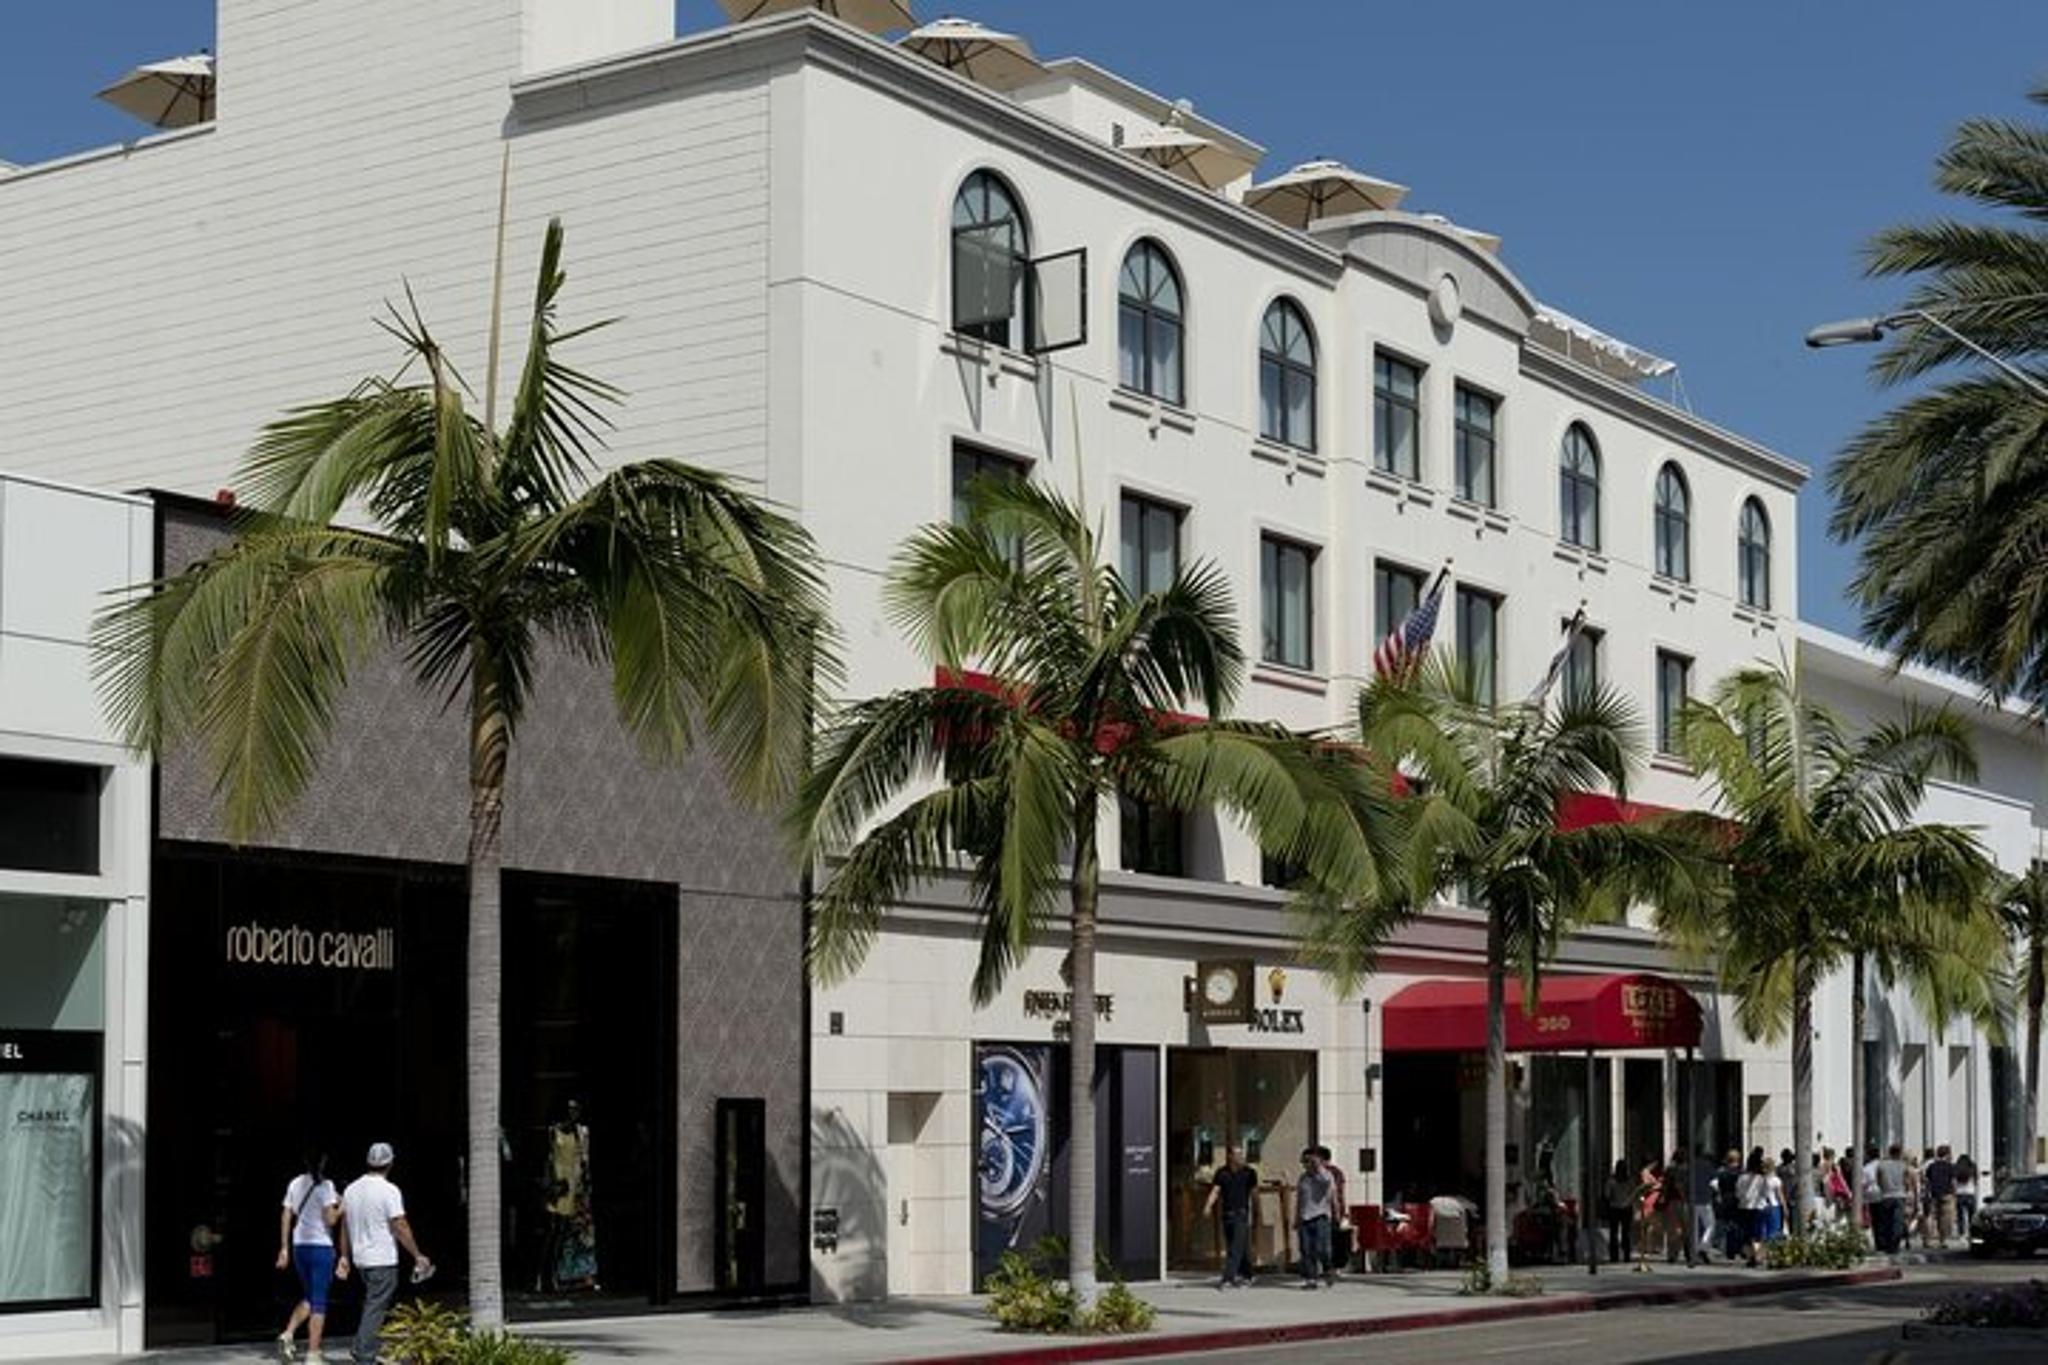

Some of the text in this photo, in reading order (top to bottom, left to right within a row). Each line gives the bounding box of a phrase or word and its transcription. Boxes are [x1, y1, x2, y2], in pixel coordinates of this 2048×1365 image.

[227, 920, 394, 970] roberto cavalli
[17, 1110, 70, 1122] CHANEL
